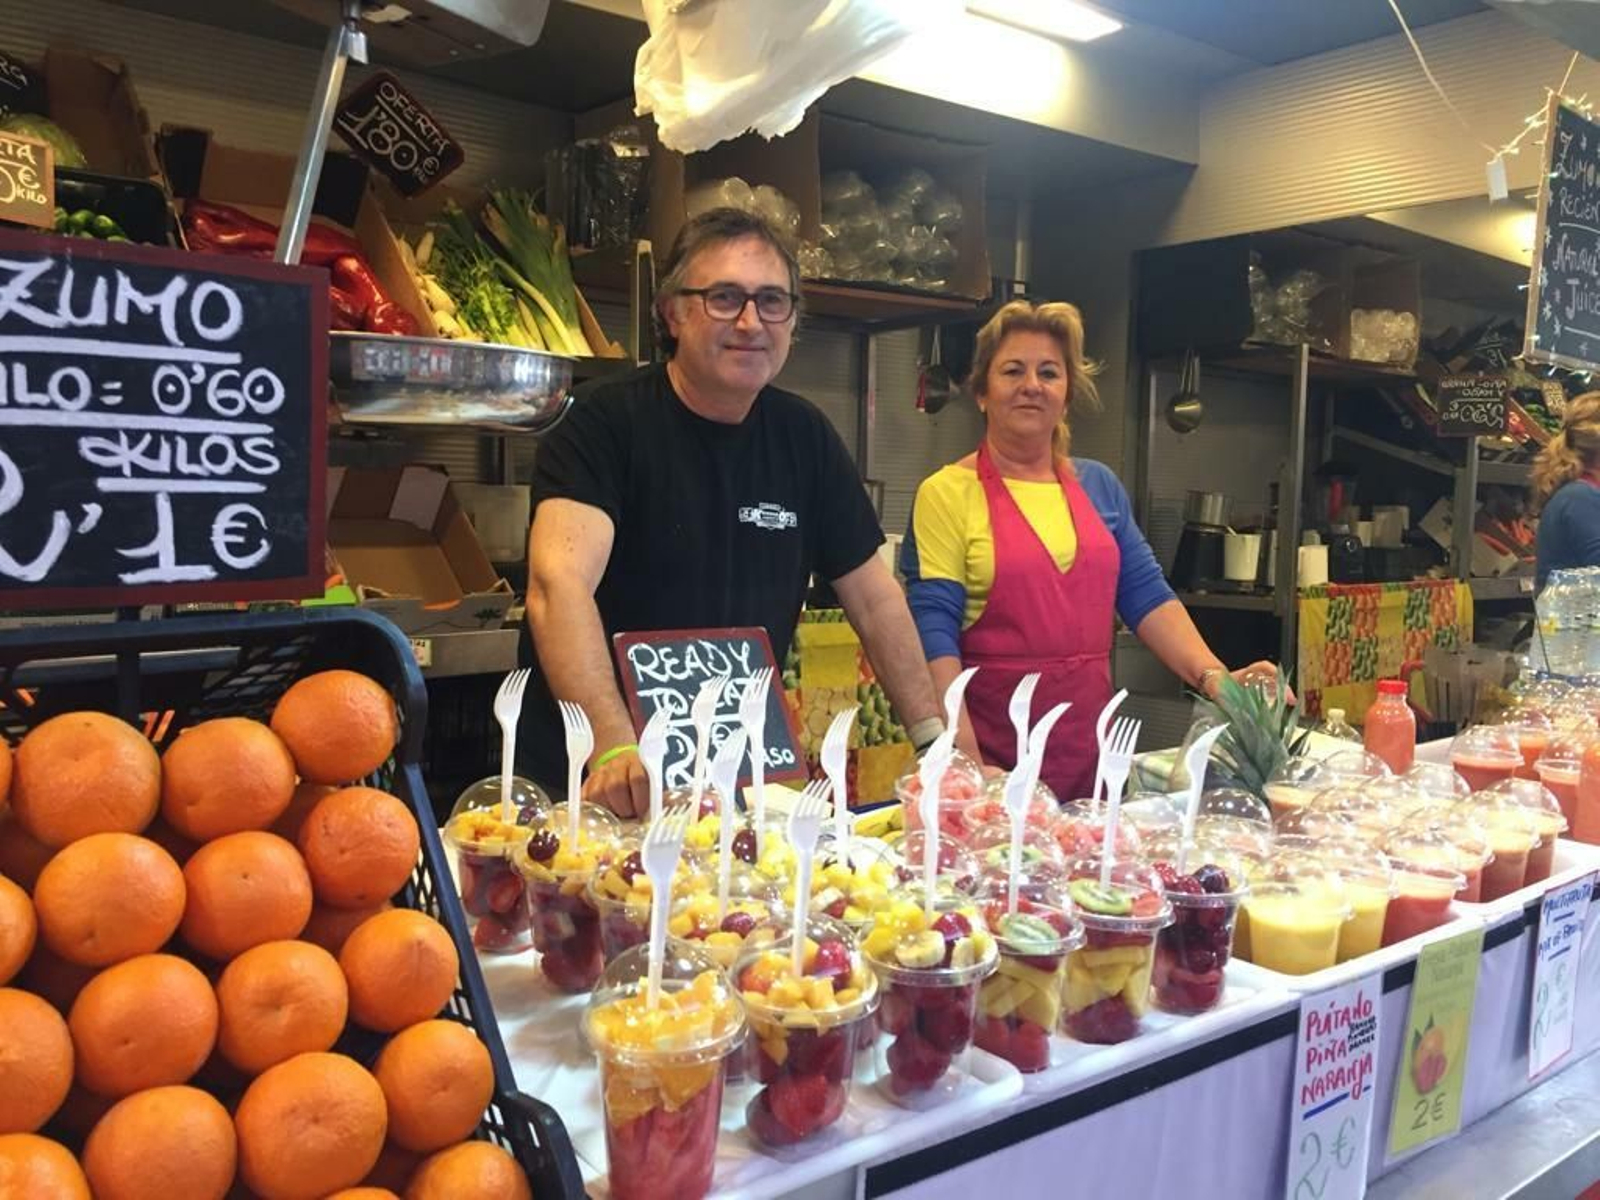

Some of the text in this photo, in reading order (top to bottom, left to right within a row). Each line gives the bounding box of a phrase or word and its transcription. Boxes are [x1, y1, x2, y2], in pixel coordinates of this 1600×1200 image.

[380, 82, 450, 156] OFERTA
[16, 185, 47, 206] KILO
[0, 258, 243, 347] ZUMO
[627, 640, 750, 682] READY
[1301, 1052, 1373, 1104] NARANJA
